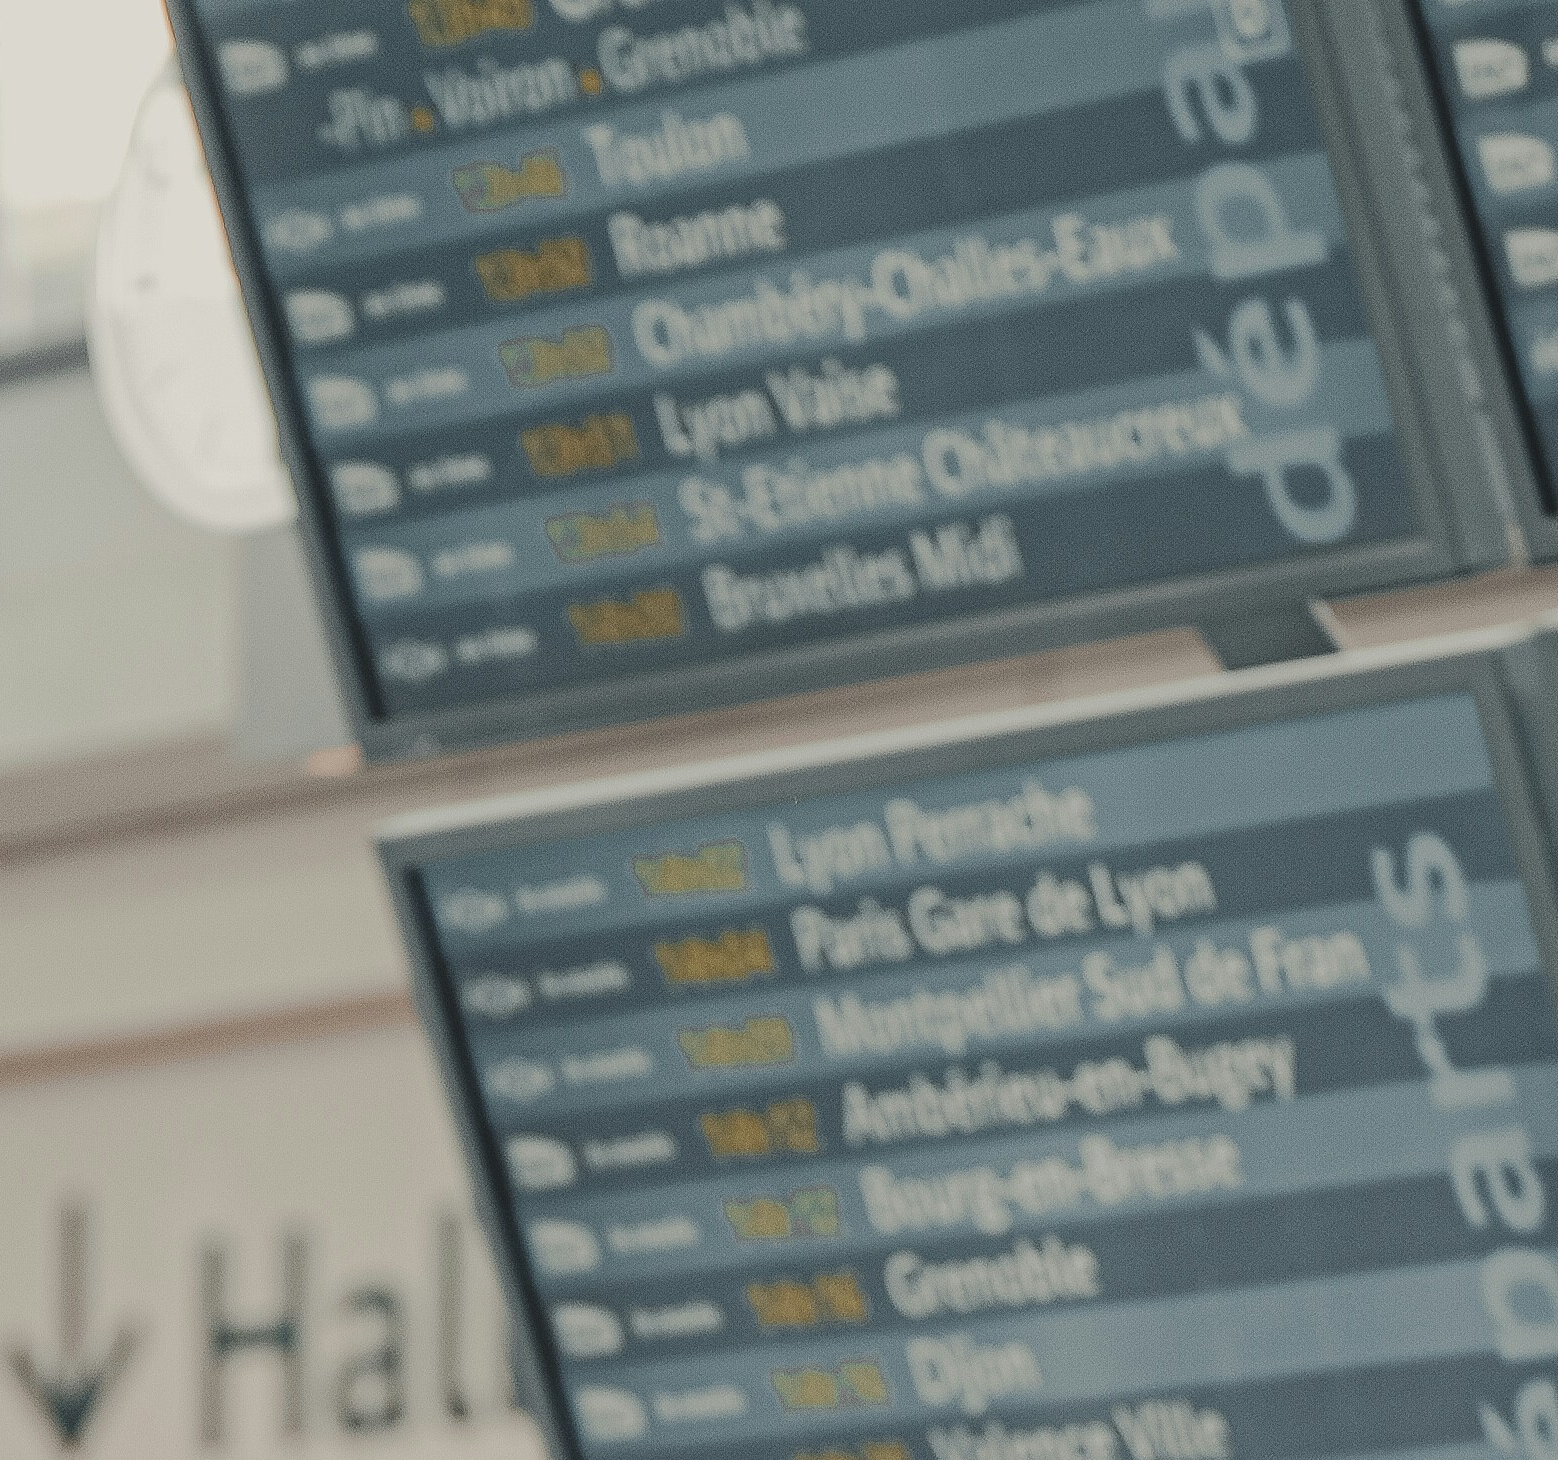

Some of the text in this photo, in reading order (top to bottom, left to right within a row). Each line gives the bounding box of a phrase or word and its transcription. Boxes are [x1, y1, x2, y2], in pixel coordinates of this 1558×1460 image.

[654, 384, 774, 464] Lyon
[767, 820, 889, 896] Lyon
[1088, 858, 1217, 936] Lyon
